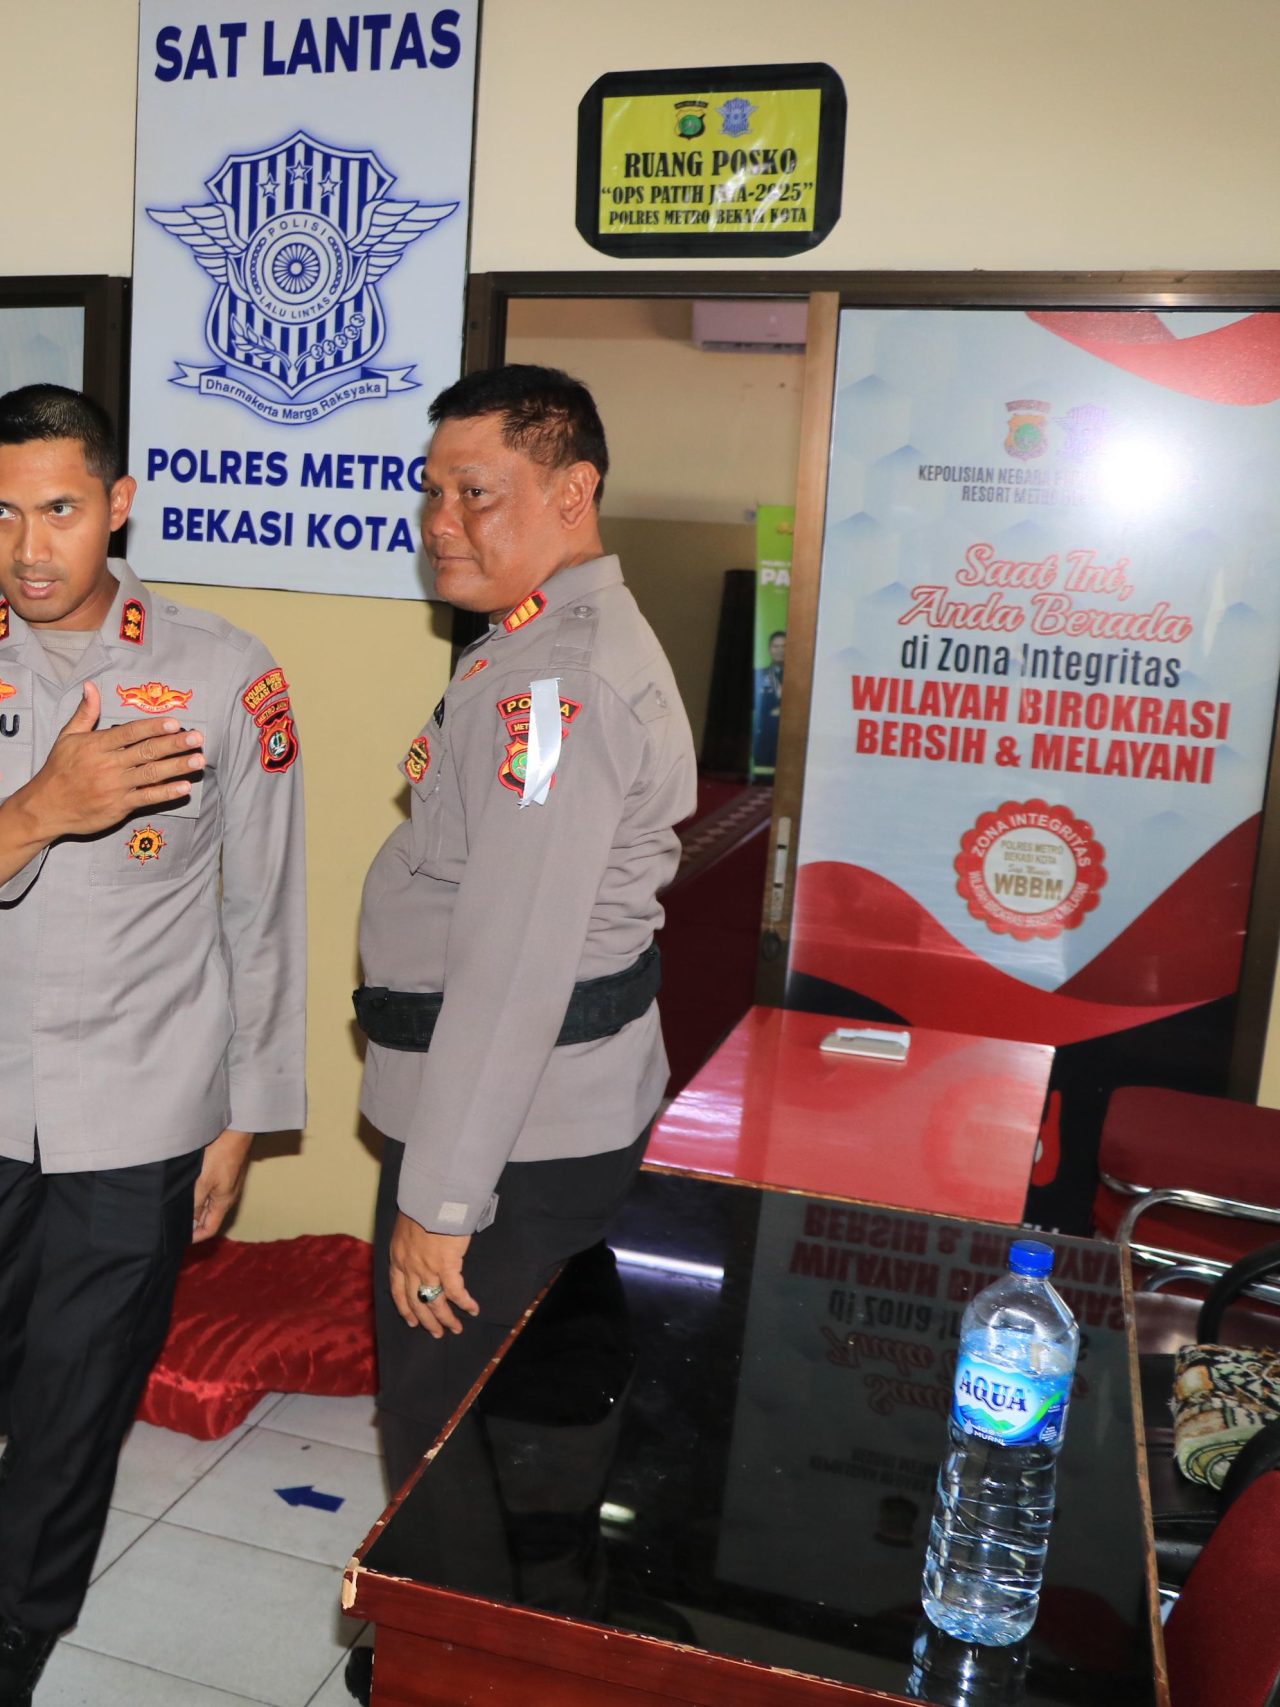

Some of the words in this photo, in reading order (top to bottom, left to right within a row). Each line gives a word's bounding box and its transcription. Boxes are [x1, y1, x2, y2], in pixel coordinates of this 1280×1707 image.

[155, 22, 247, 82] SAT
[263, 9, 461, 76] LANTAS
[624, 151, 703, 177] RUANG
[711, 148, 797, 176] POSKO
[650, 184, 704, 204] PATUH
[268, 219, 327, 238] POLISI
[609, 210, 659, 225] POLRES
[664, 210, 710, 225] METRO
[770, 207, 806, 223] KOTA
[259, 296, 287, 317] LALU
[291, 297, 331, 319] LINTAS
[206, 379, 279, 417] Dharmakerta
[282, 408, 319, 421] Marga
[320, 383, 381, 411] Raksyaka
[147, 448, 288, 486] POLRES
[300, 453, 429, 493] METRO
[919, 465, 994, 484] KEPOLISIAN
[962, 485, 1010, 503] RESORT
[162, 507, 293, 546] BEKASI
[307, 513, 415, 553] KOTA
[956, 543, 1059, 587] Saat
[898, 585, 1024, 631] Anda
[1031, 593, 1193, 643] Berada
[901, 634, 929, 669] di
[937, 638, 1009, 676] Zona
[1020, 643, 1181, 688] Integritas
[507, 697, 570, 717] POA
[851, 675, 1009, 722] WILAYAH
[1018, 688, 1231, 740] BIROKRASI
[855, 718, 986, 764] BERSIH
[995, 735, 1021, 767] &
[1030, 733, 1216, 784] MELAYANI
[972, 821, 1009, 858] ZONA
[1009, 813, 1091, 867] INTEGRITAS
[994, 873, 1063, 900] WBBM
[960, 1370, 1027, 1412] AQUA
